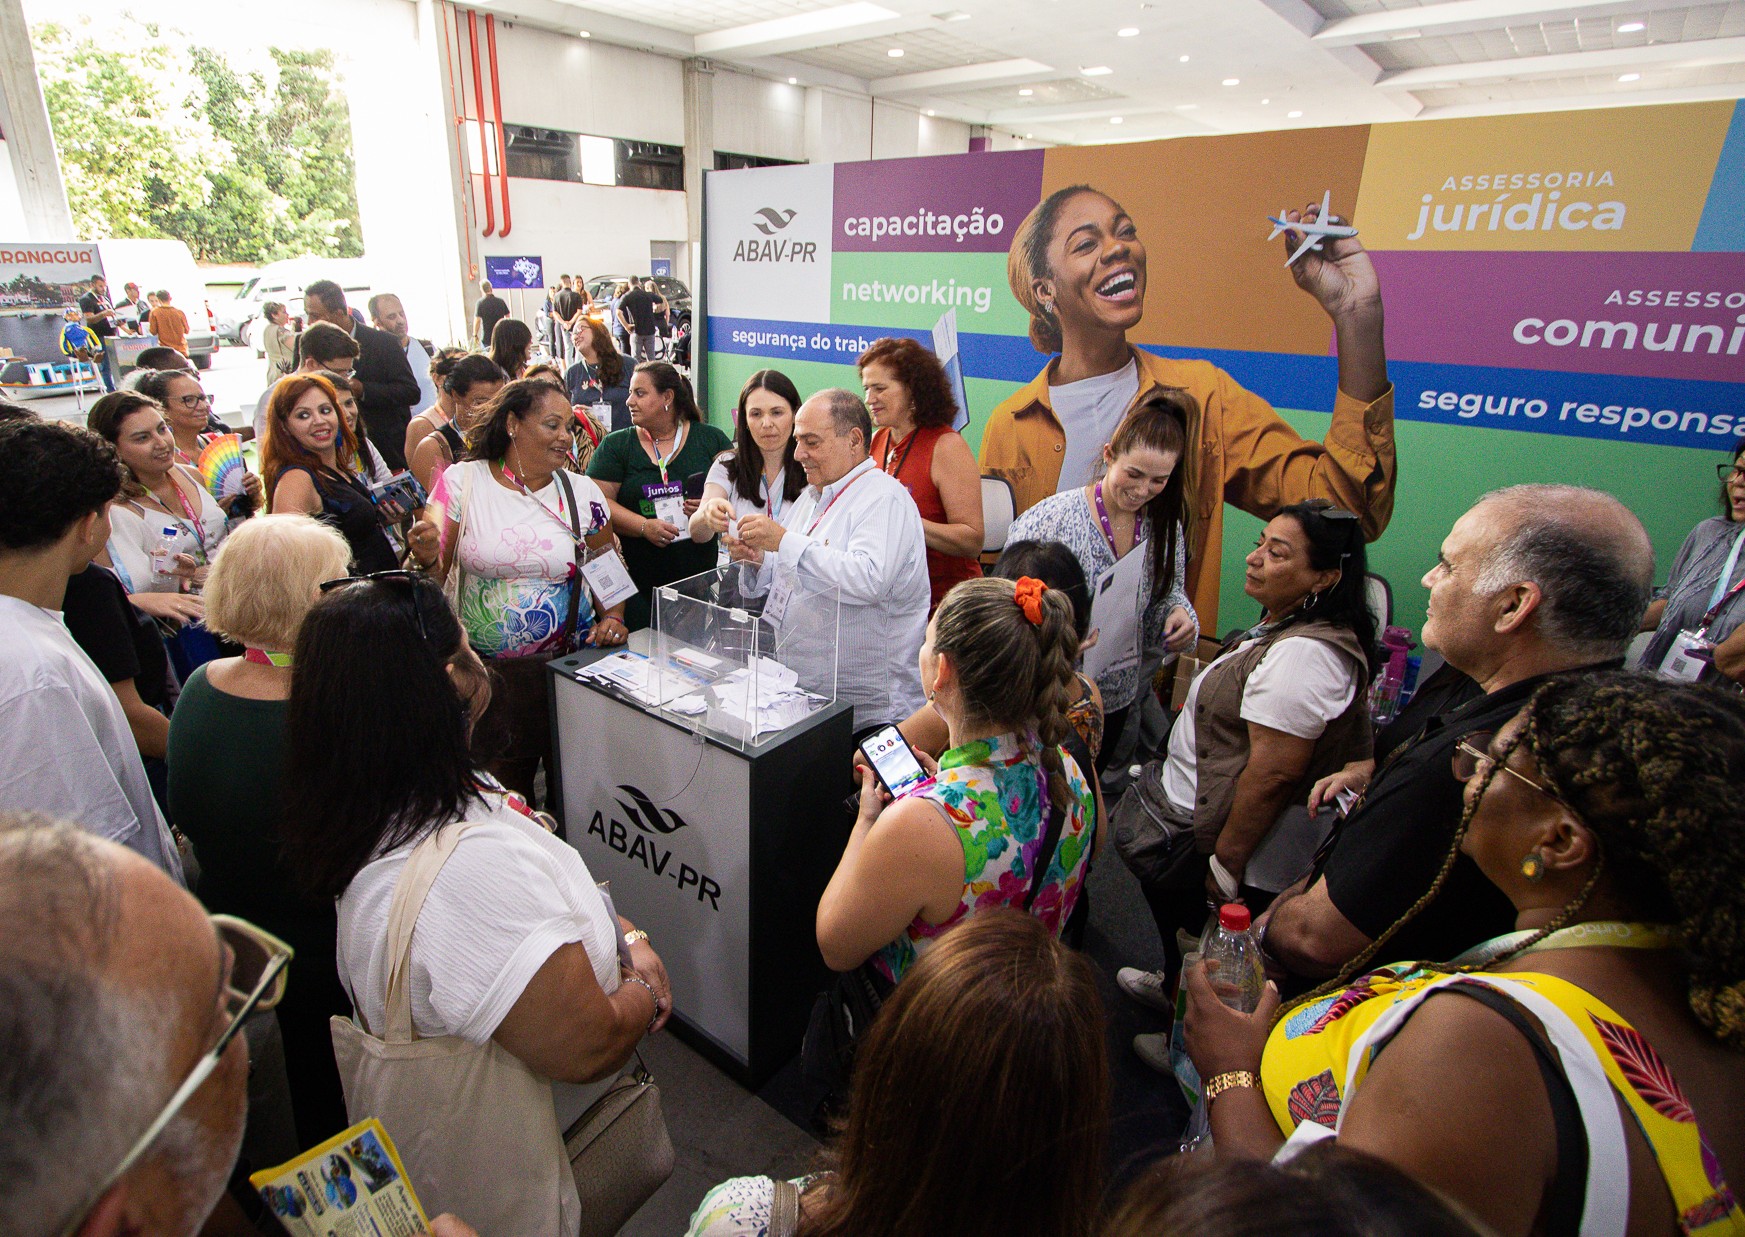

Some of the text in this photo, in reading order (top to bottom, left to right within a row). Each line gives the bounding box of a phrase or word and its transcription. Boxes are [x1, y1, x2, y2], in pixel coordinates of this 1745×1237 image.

[1440, 170, 1615, 191] ASSESSORIA
[843, 207, 1004, 243] capacitação
[1406, 190, 1627, 241] jurídica
[0, 249, 93, 264] RANAGUÁ
[732, 239, 817, 263] ABAV-PR
[842, 278, 992, 313] networking
[732, 330, 876, 353] segurança do trab
[1417, 389, 1548, 418] seguro
[587, 809, 722, 912] ABAV-PR
